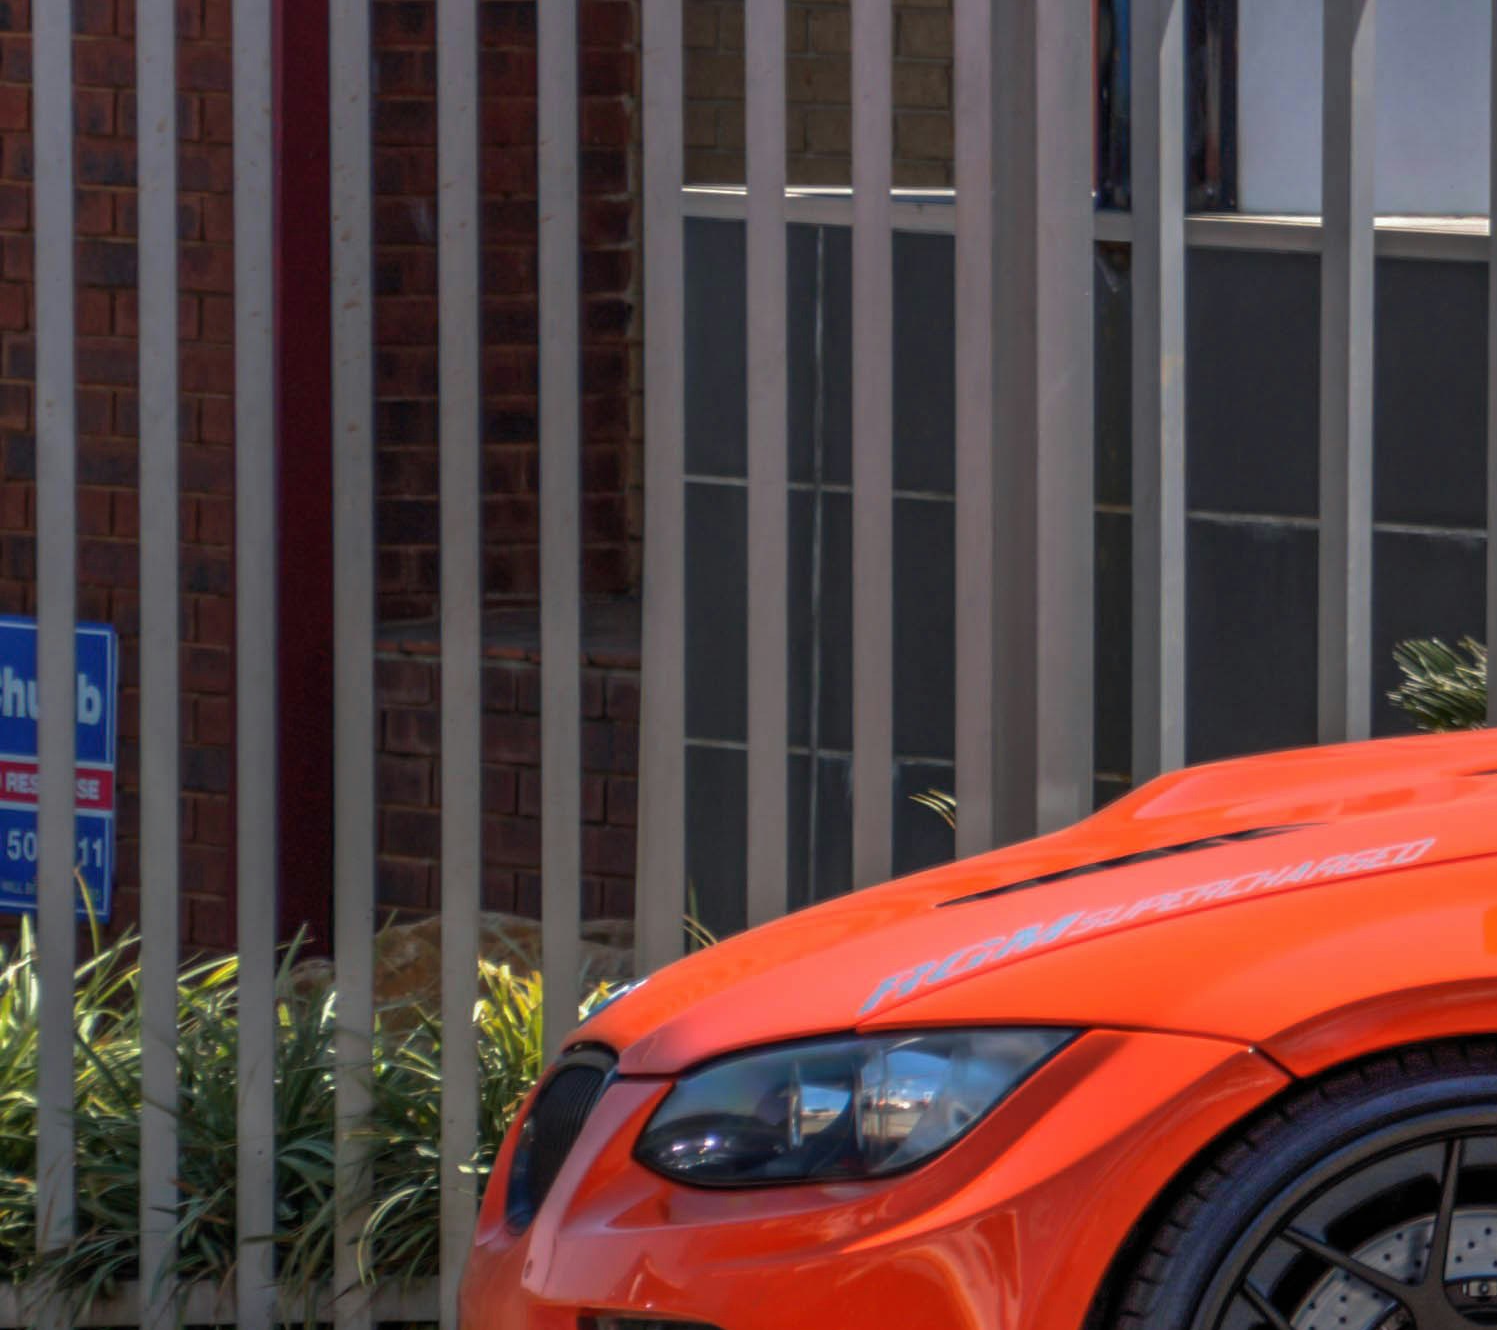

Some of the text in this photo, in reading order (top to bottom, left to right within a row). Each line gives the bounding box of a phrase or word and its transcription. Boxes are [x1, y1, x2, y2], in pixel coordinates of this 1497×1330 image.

[0, 666, 103, 726] hub
[5, 773, 100, 800] RESSE
[857, 838, 1437, 1017] RGM SUPERCHARGED
